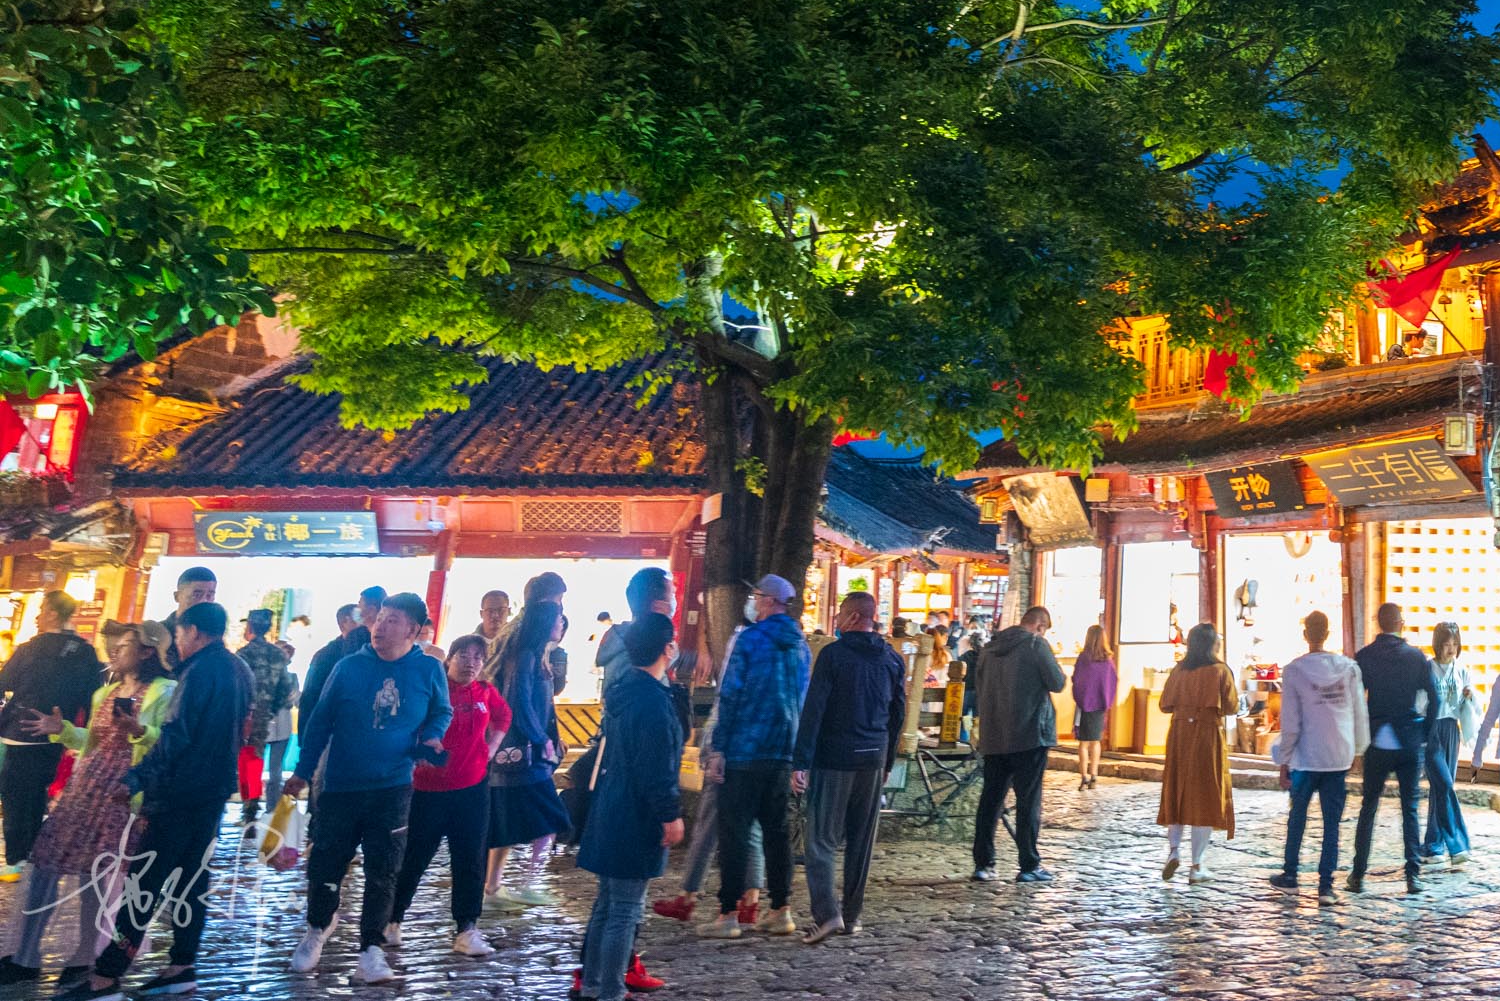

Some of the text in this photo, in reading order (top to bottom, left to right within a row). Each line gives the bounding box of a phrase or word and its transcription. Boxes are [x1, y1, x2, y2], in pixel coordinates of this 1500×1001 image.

[1228, 473, 1271, 502] 开物
[1318, 449, 1459, 493] 三生有信
